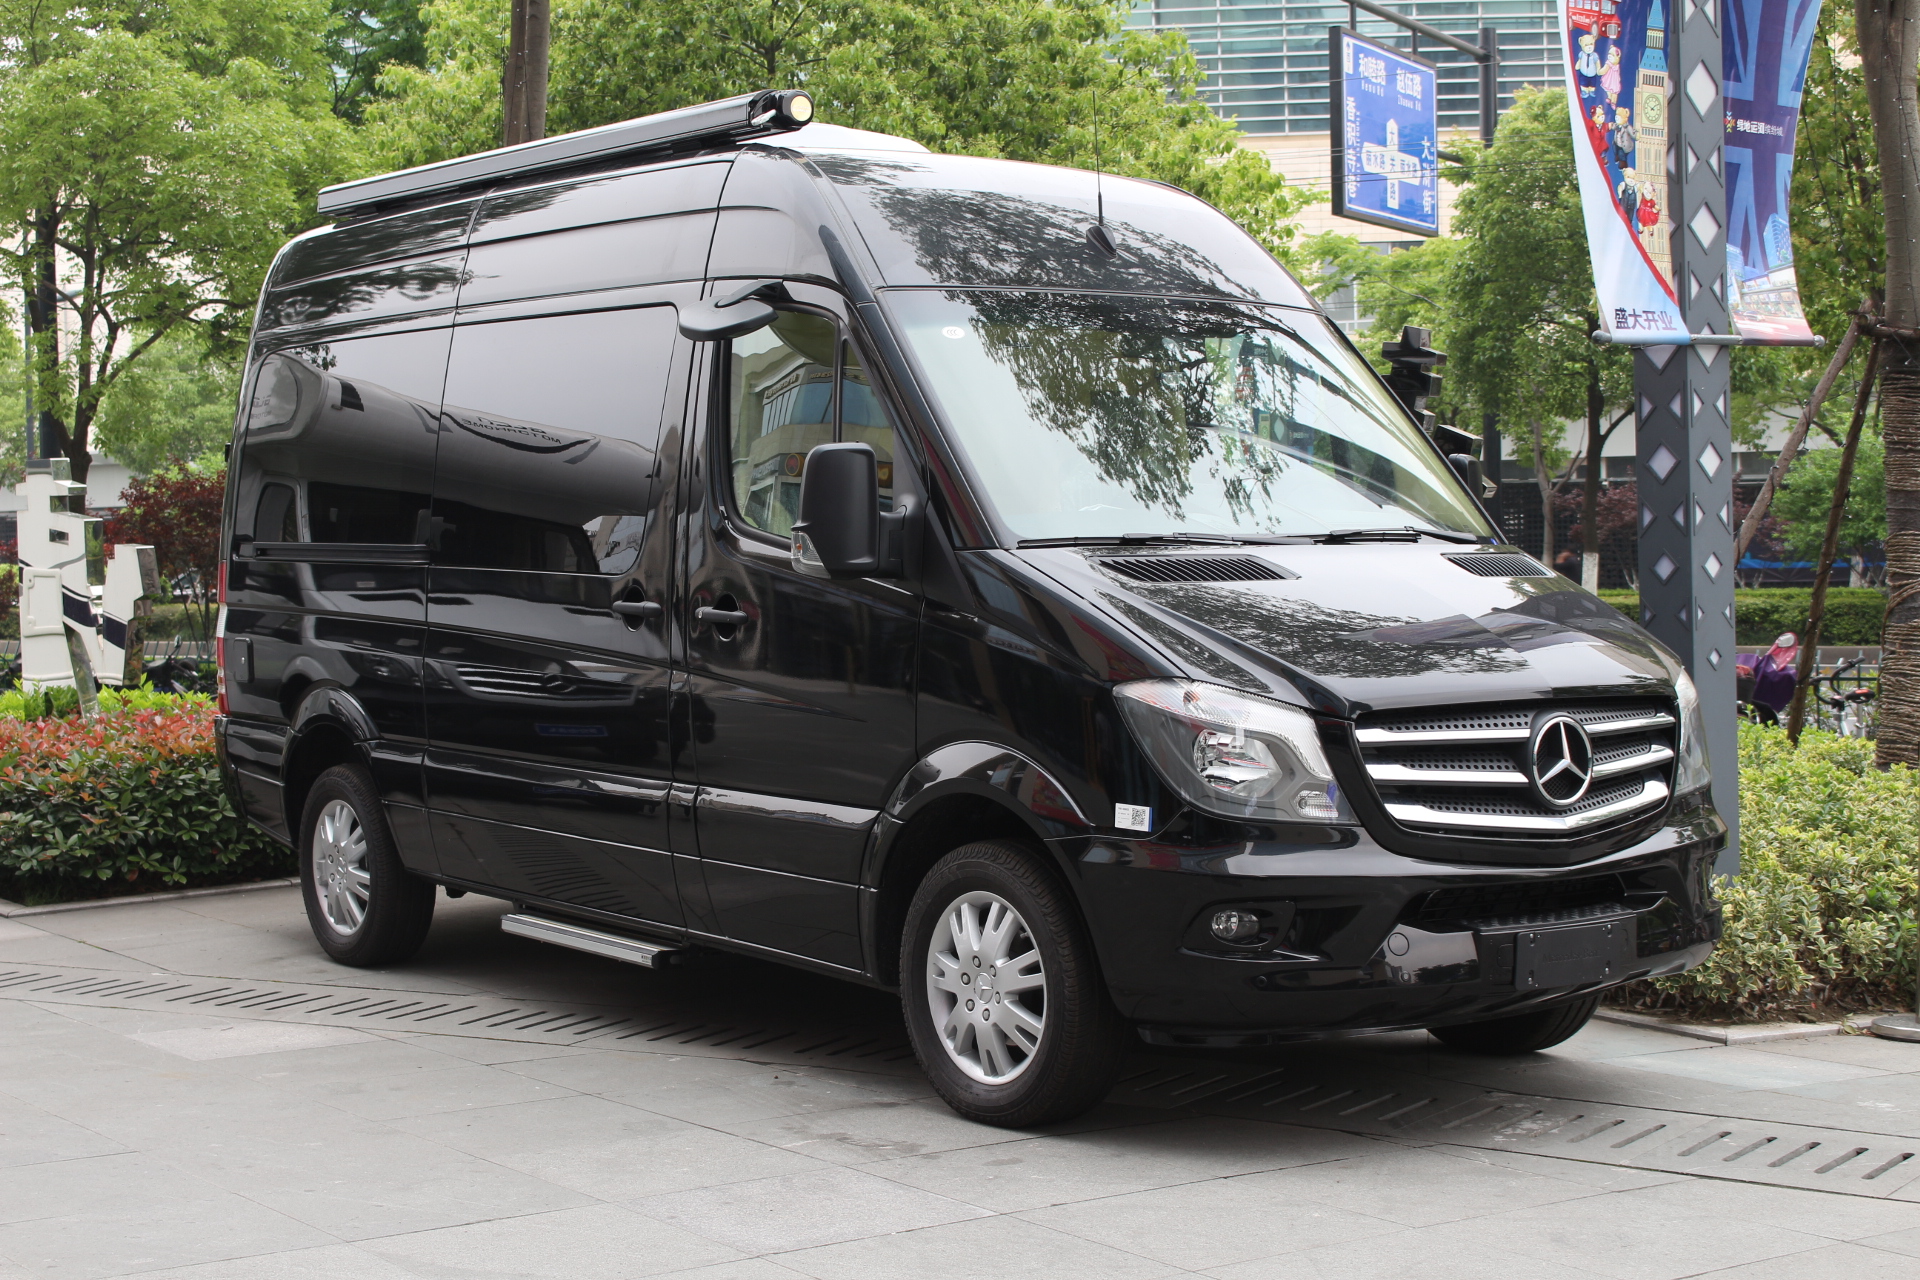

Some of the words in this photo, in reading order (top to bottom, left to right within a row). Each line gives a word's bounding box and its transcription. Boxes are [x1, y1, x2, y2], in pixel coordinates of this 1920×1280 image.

[1358, 53, 1387, 86] 和睦路
[1614, 307, 1678, 331] 盛大开业
